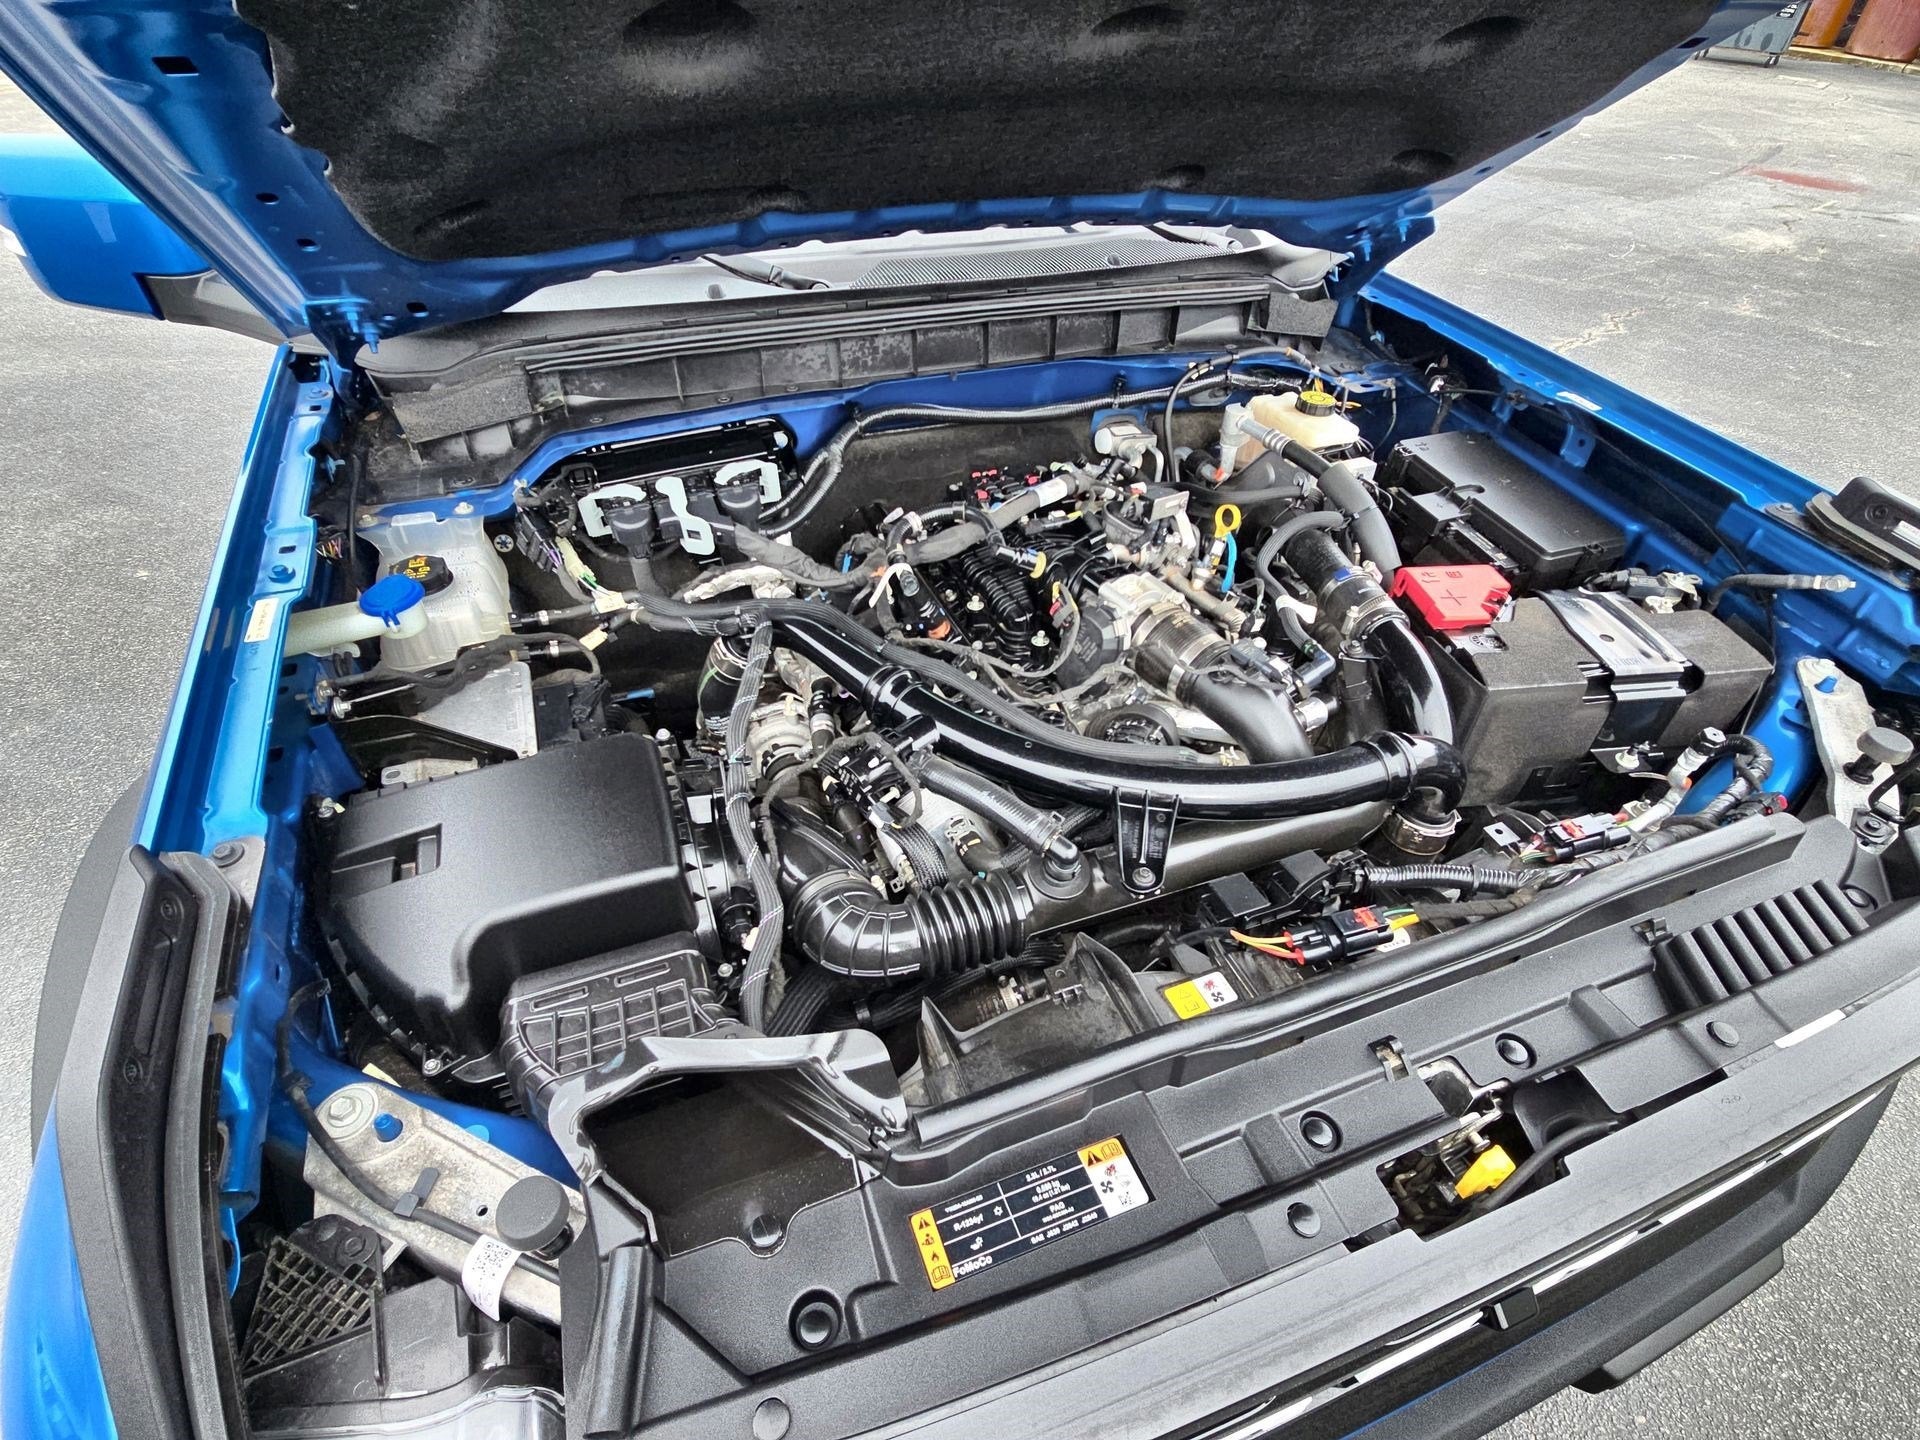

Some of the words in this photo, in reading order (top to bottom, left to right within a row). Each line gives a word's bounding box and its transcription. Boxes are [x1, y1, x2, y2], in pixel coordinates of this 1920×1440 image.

[1049, 1201, 1066, 1213] PAG
[953, 1213, 984, 1232] R-1234yf
[952, 1255, 993, 1278] FoMoCo
